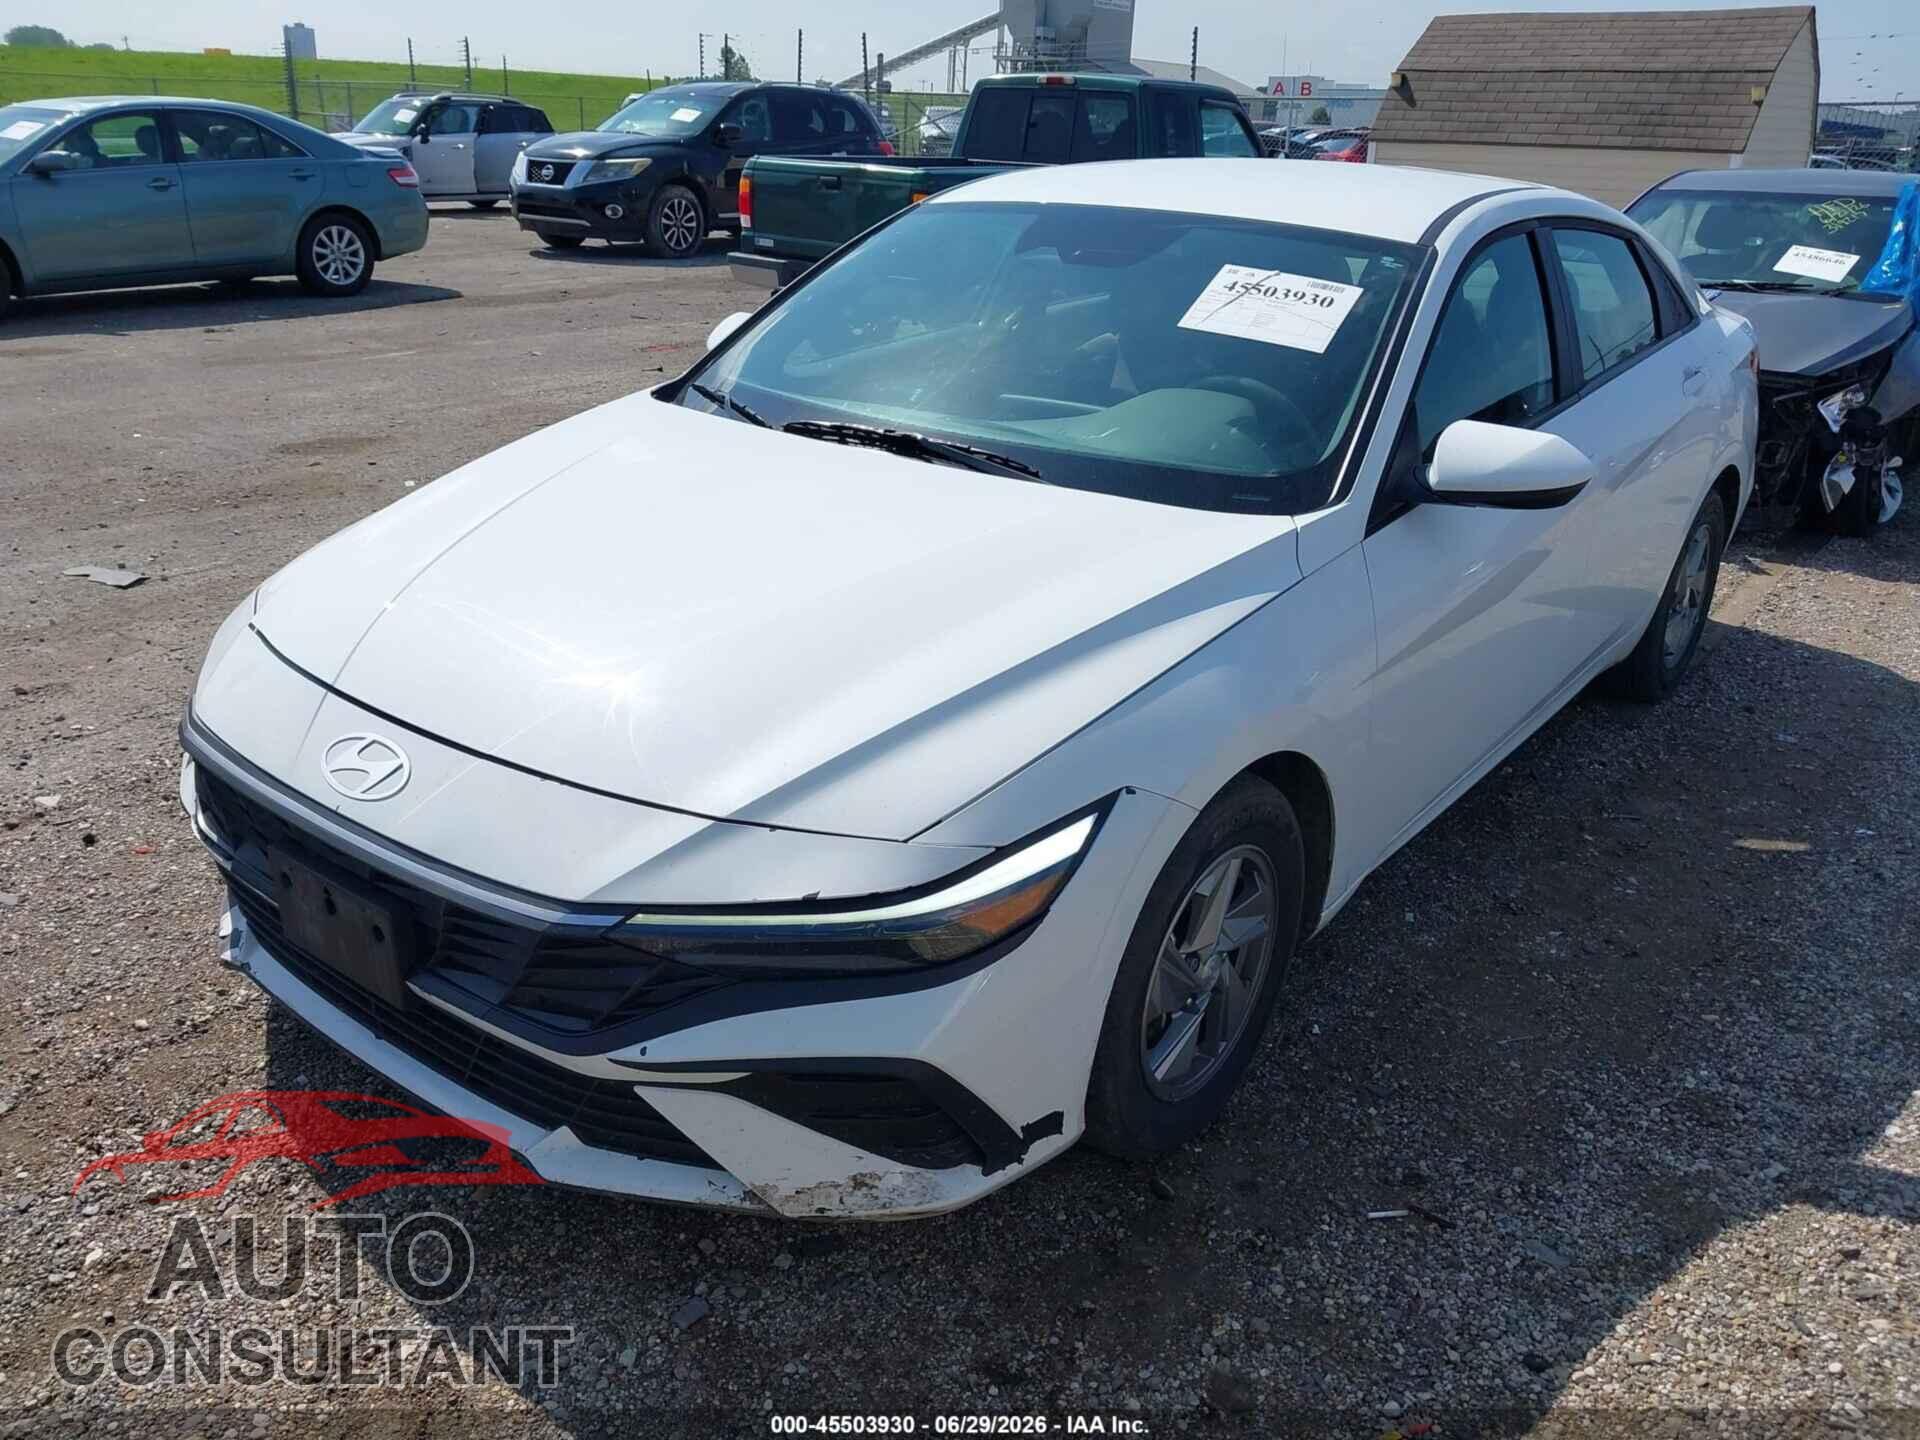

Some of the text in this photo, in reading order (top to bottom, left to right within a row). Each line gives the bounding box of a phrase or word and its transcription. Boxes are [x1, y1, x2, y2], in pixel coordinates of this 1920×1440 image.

[1272, 82, 1312, 96] A B
[1223, 280, 1335, 309] 45503930
